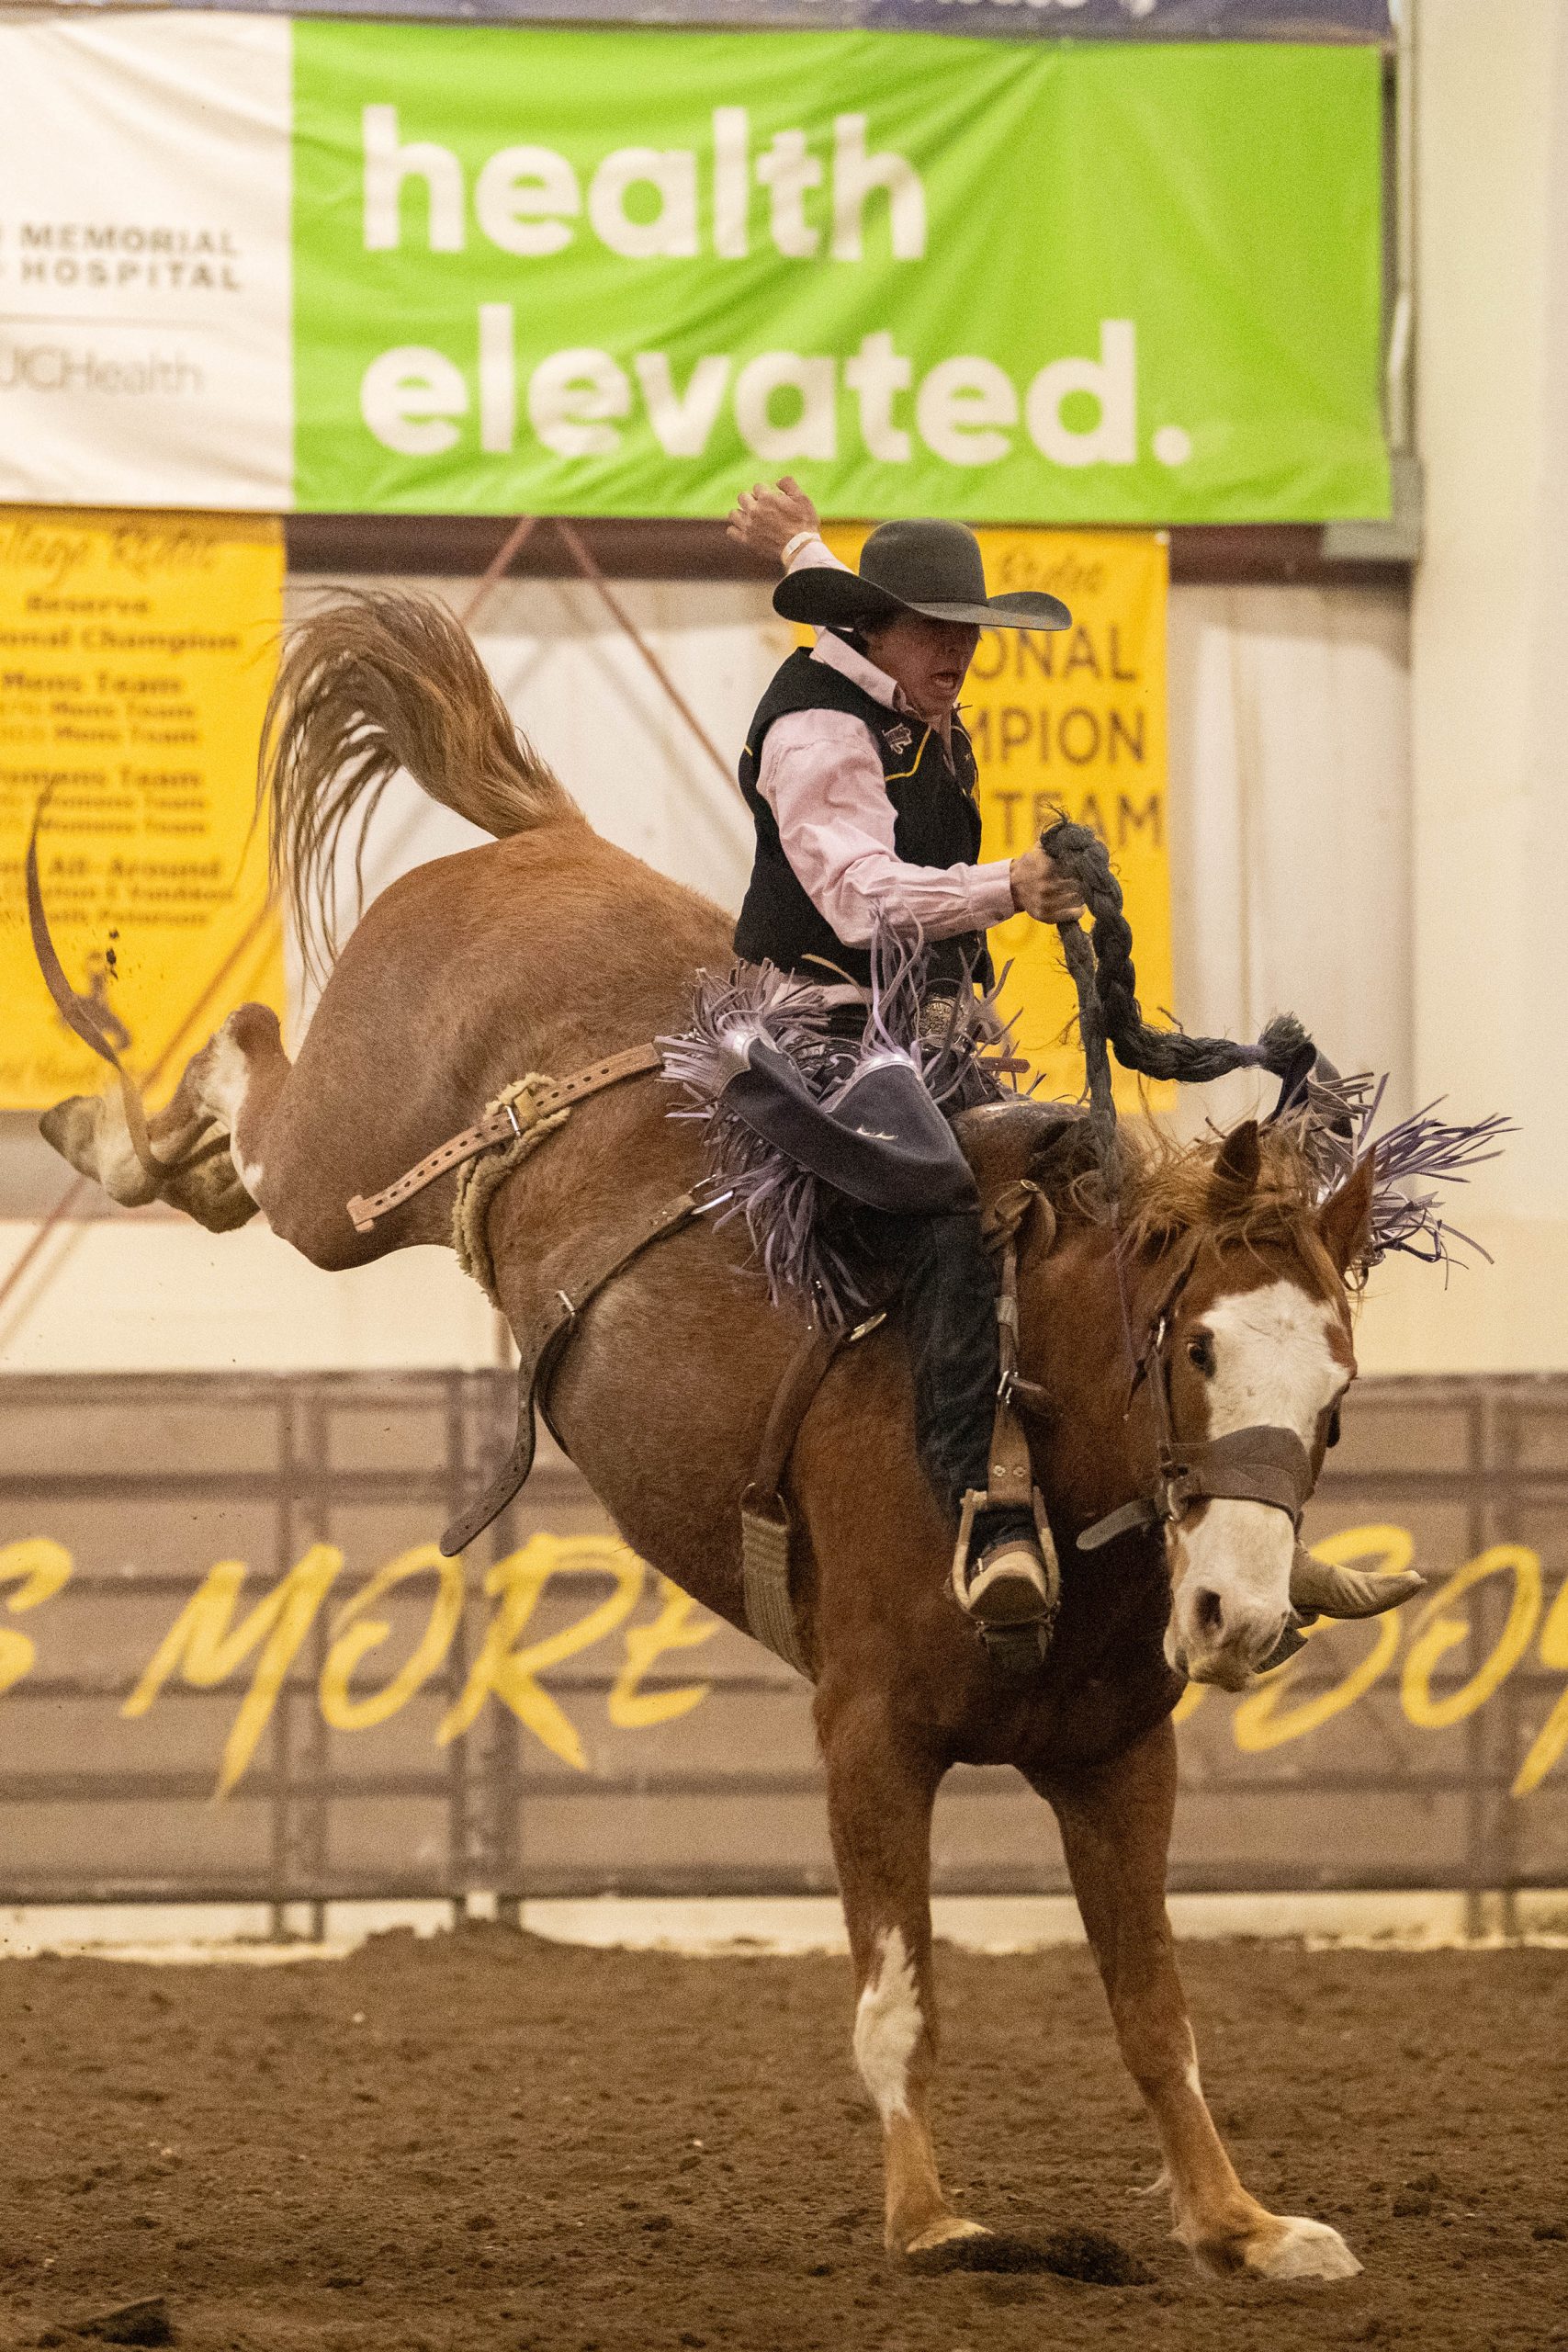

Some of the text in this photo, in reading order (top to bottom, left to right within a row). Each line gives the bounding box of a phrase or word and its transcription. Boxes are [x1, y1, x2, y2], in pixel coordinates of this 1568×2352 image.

[362, 103, 927, 260] health
[19, 222, 241, 257] MEMORIAL
[19, 257, 242, 291] HOSPITAL
[360, 301, 1192, 467] elevated.
[0, 628, 239, 654] onal Champion
[970, 625, 1140, 684] ONAL
[97, 672, 183, 692] Team
[121, 766, 202, 789] Team
[993, 789, 1164, 850] TEAM
[119, 1531, 720, 1810] MORE
